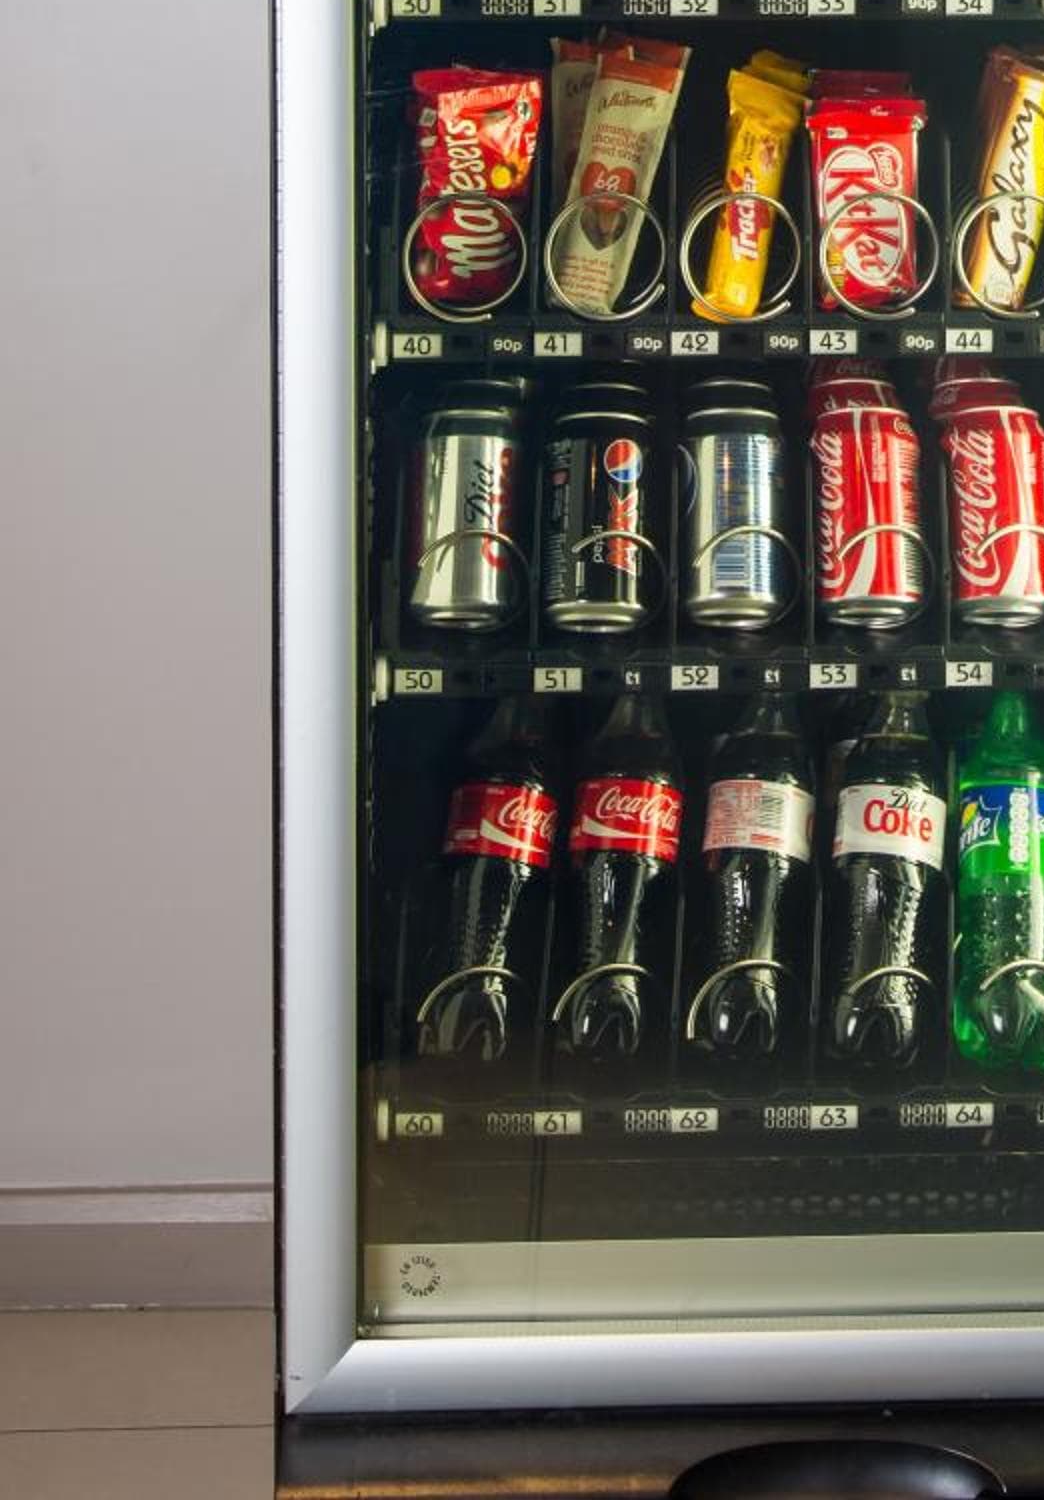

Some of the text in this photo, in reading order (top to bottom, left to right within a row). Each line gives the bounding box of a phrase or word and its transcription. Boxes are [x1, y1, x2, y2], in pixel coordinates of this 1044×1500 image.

[403, 335, 523, 354] 40 90p
[543, 335, 663, 353] 41 90p
[681, 334, 799, 352] 42 90p
[819, 333, 935, 351] 43 90p
[955, 331, 982, 350] 44
[405, 671, 432, 689] 50
[545, 671, 569, 689] 51
[681, 666, 709, 686] 52
[820, 665, 848, 684] 53
[956, 663, 982, 681] 54
[544, 1113, 568, 1132] 61
[679, 1109, 709, 1130] 62
[819, 1106, 848, 1127] 63
[956, 1104, 982, 1124] 64
[406, 1115, 433, 1134] 60
